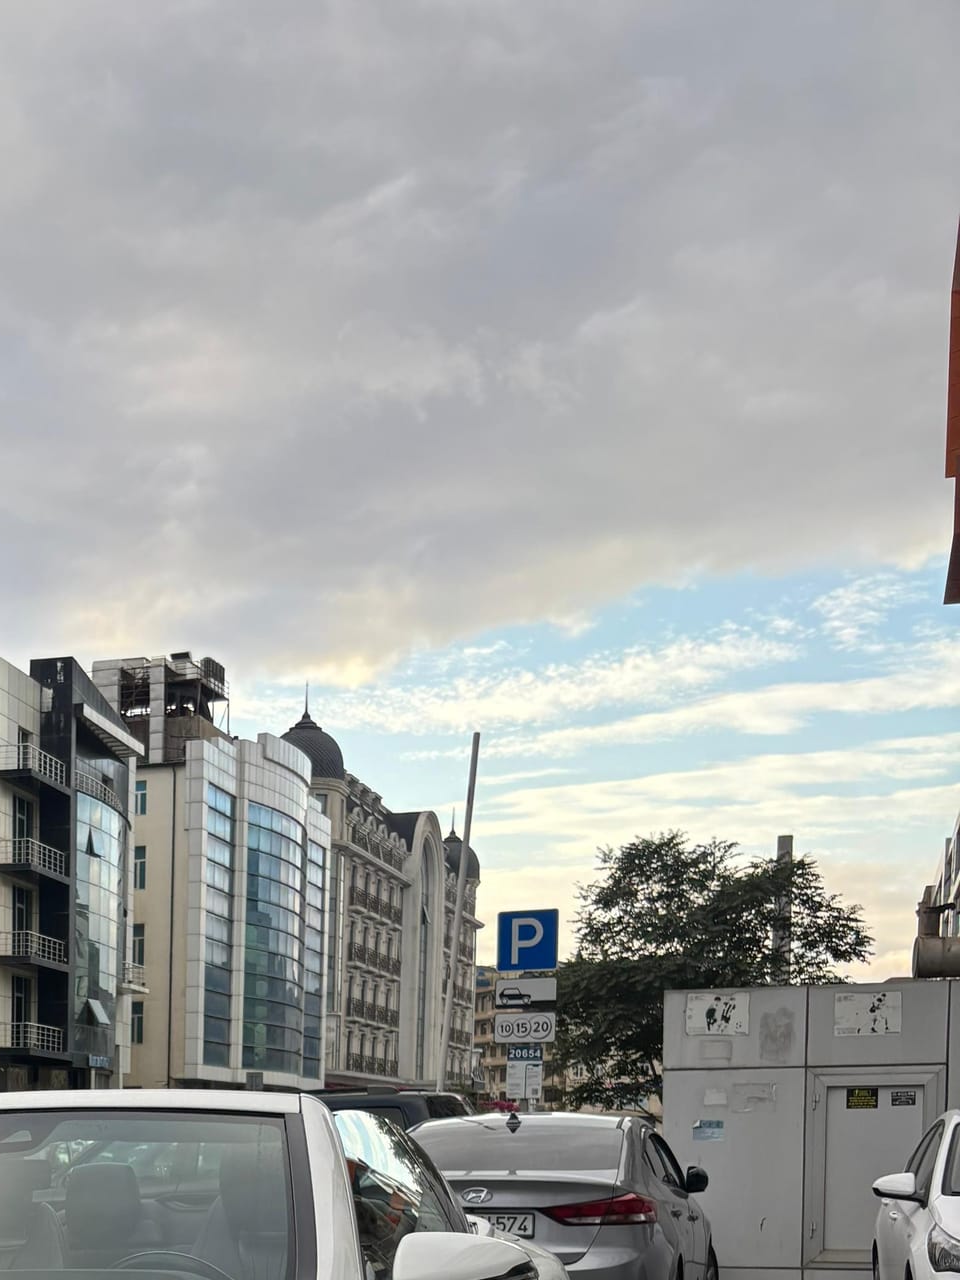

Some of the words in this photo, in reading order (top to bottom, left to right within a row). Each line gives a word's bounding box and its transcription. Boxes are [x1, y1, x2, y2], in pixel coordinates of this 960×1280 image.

[511, 917, 544, 965] P
[500, 1024, 512, 1034] 10
[516, 1022, 528, 1034] 15
[533, 1021, 549, 1033] 20
